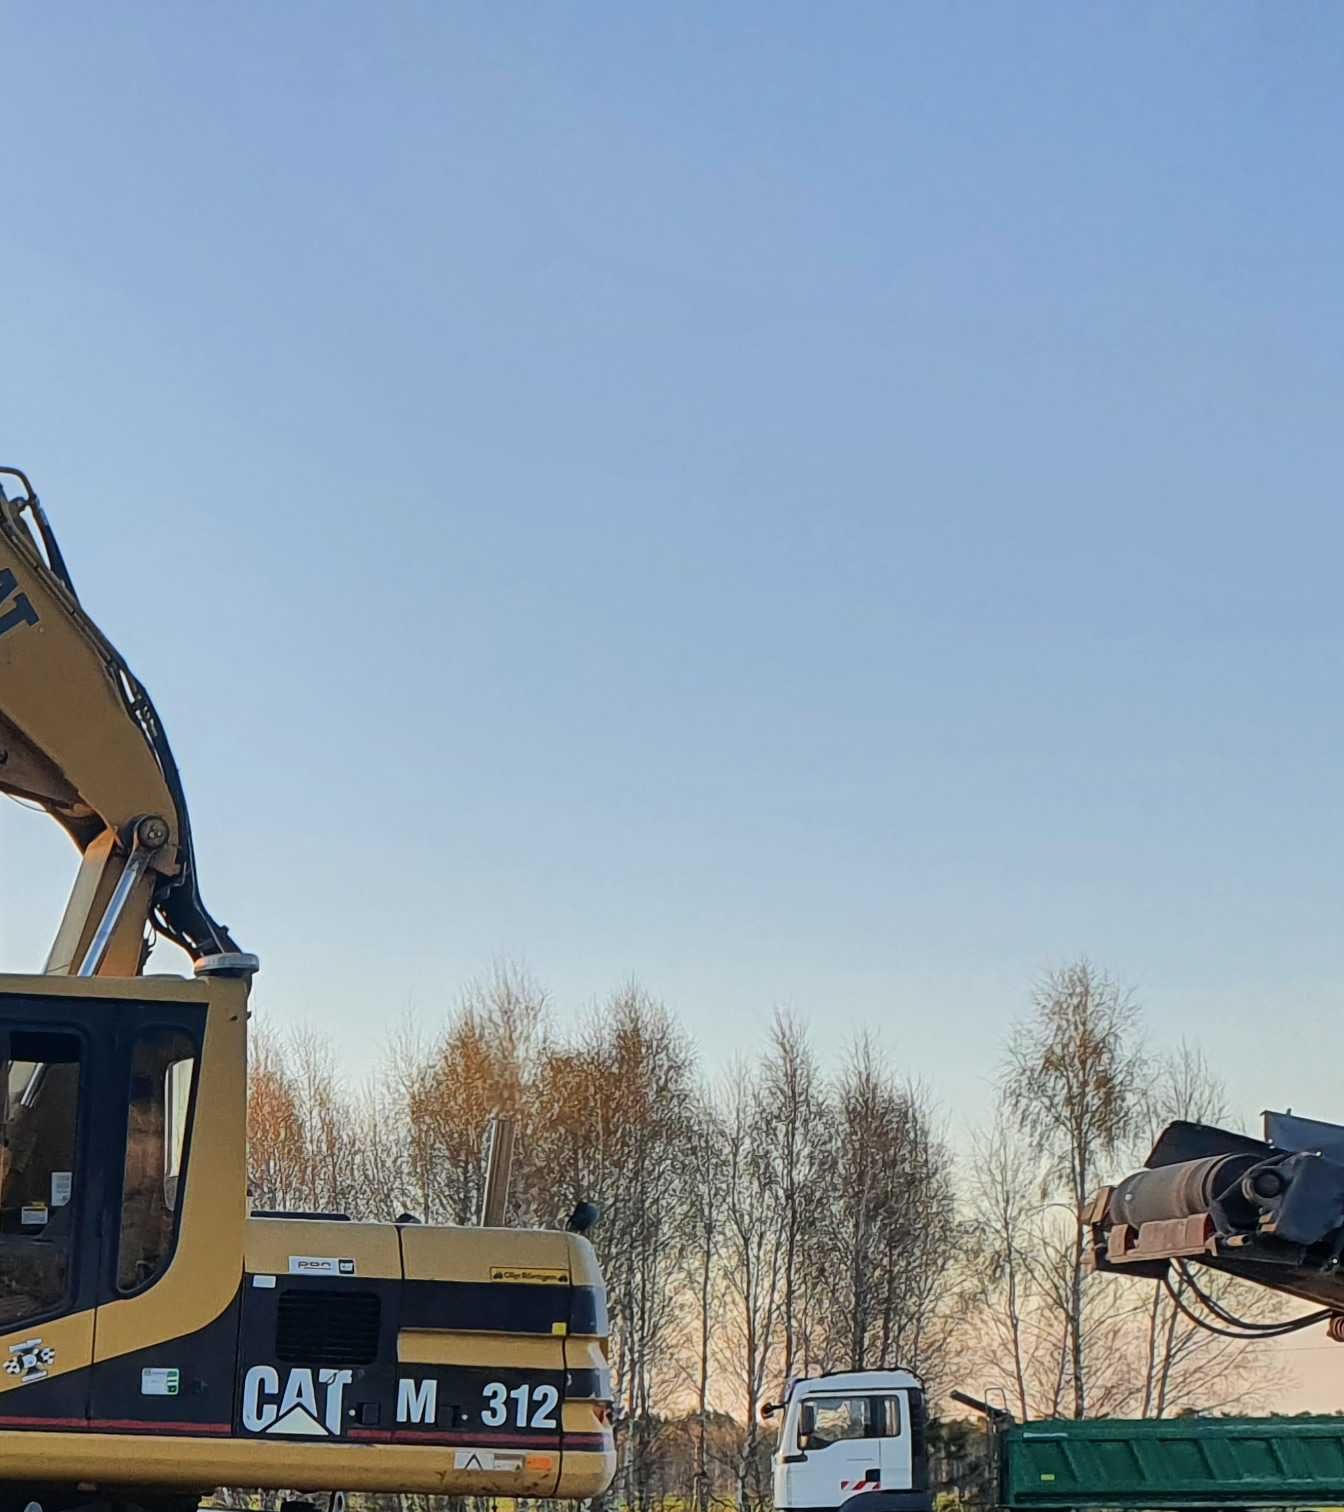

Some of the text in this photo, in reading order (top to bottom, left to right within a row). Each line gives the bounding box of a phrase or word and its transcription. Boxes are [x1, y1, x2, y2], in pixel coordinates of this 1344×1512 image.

[242, 1365, 559, 1436] CAT M 312
